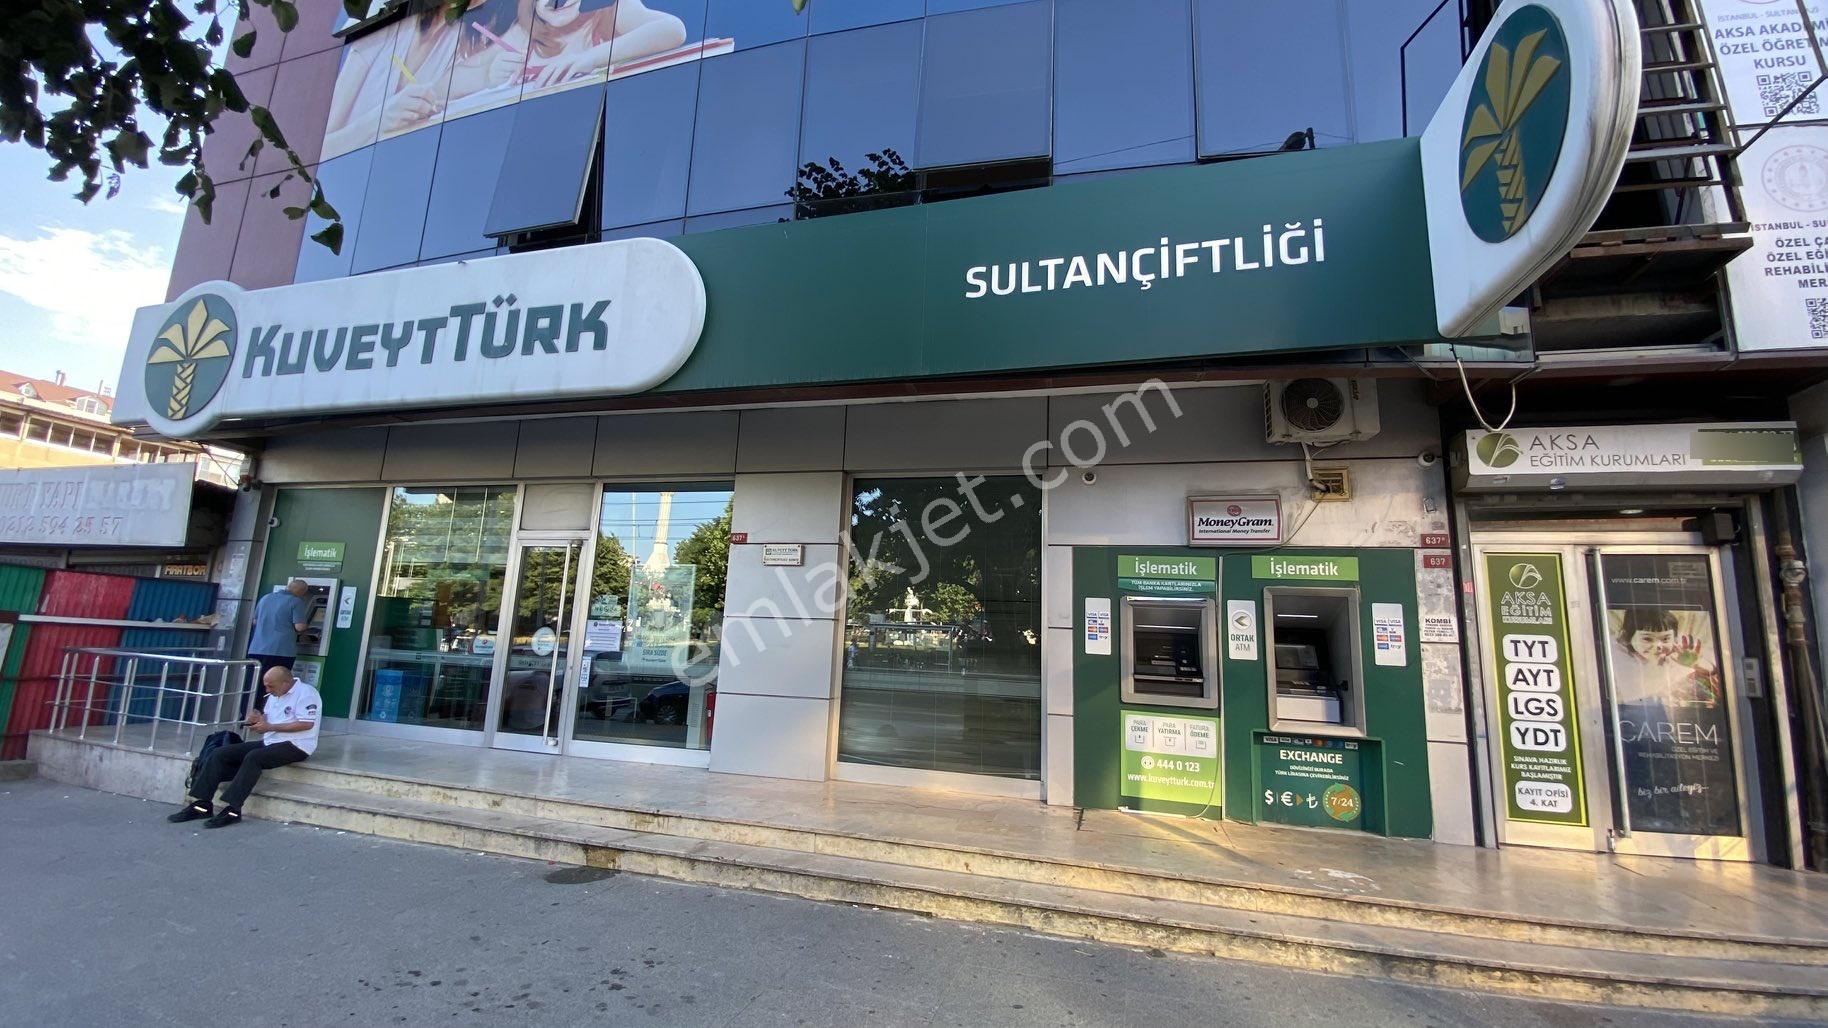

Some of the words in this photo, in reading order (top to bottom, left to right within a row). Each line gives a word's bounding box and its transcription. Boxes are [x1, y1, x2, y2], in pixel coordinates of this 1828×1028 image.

[1714, 26, 1755, 40] AKSA
[1719, 42, 1759, 55] ÖZEL
[1753, 54, 1807, 70] KURSU
[1775, 237, 1810, 248] ÖZEL
[965, 217, 1325, 299] SULTANÇİFTLİĞİ
[1766, 251, 1802, 262] ÖZEL
[1529, 434, 1600, 451] AKSA
[1530, 453, 1586, 467] EĞİTİM
[1590, 452, 1686, 467] KURUMLARI
[1197, 517, 1272, 529] MoneyGram
[304, 545, 337, 559] İşlematik
[1135, 557, 1197, 576] İşlematik
[1270, 557, 1339, 578] İşlematik
[1430, 557, 1446, 566] 637
[1609, 576, 1687, 584] www.carem.com.tr
[1501, 591, 1551, 605] AKSA
[1501, 604, 1552, 617] EĞİTİM
[1231, 634, 1255, 642] ORTAK
[1235, 643, 1251, 652] ATM
[1510, 640, 1549, 658] TYT
[1512, 668, 1554, 687] AYT
[1513, 697, 1558, 717] LGS
[1158, 727, 1181, 736] YATIRMA
[1515, 726, 1561, 748] YDT
[1619, 720, 1718, 745] CAREM
[1279, 749, 1343, 764] EXCHANGE
[1156, 759, 1175, 770] 444
[1176, 760, 1183, 771] 0
[1185, 761, 1200, 772] 123
[1511, 762, 1528, 770] KURS
[1127, 773, 1215, 789] www.kuveytturk.com.tr
[1517, 787, 1542, 796] KAYIT
[1545, 788, 1569, 798] OFİSİ
[1331, 796, 1354, 808] 7/24
[1541, 799, 1557, 807] KAT
